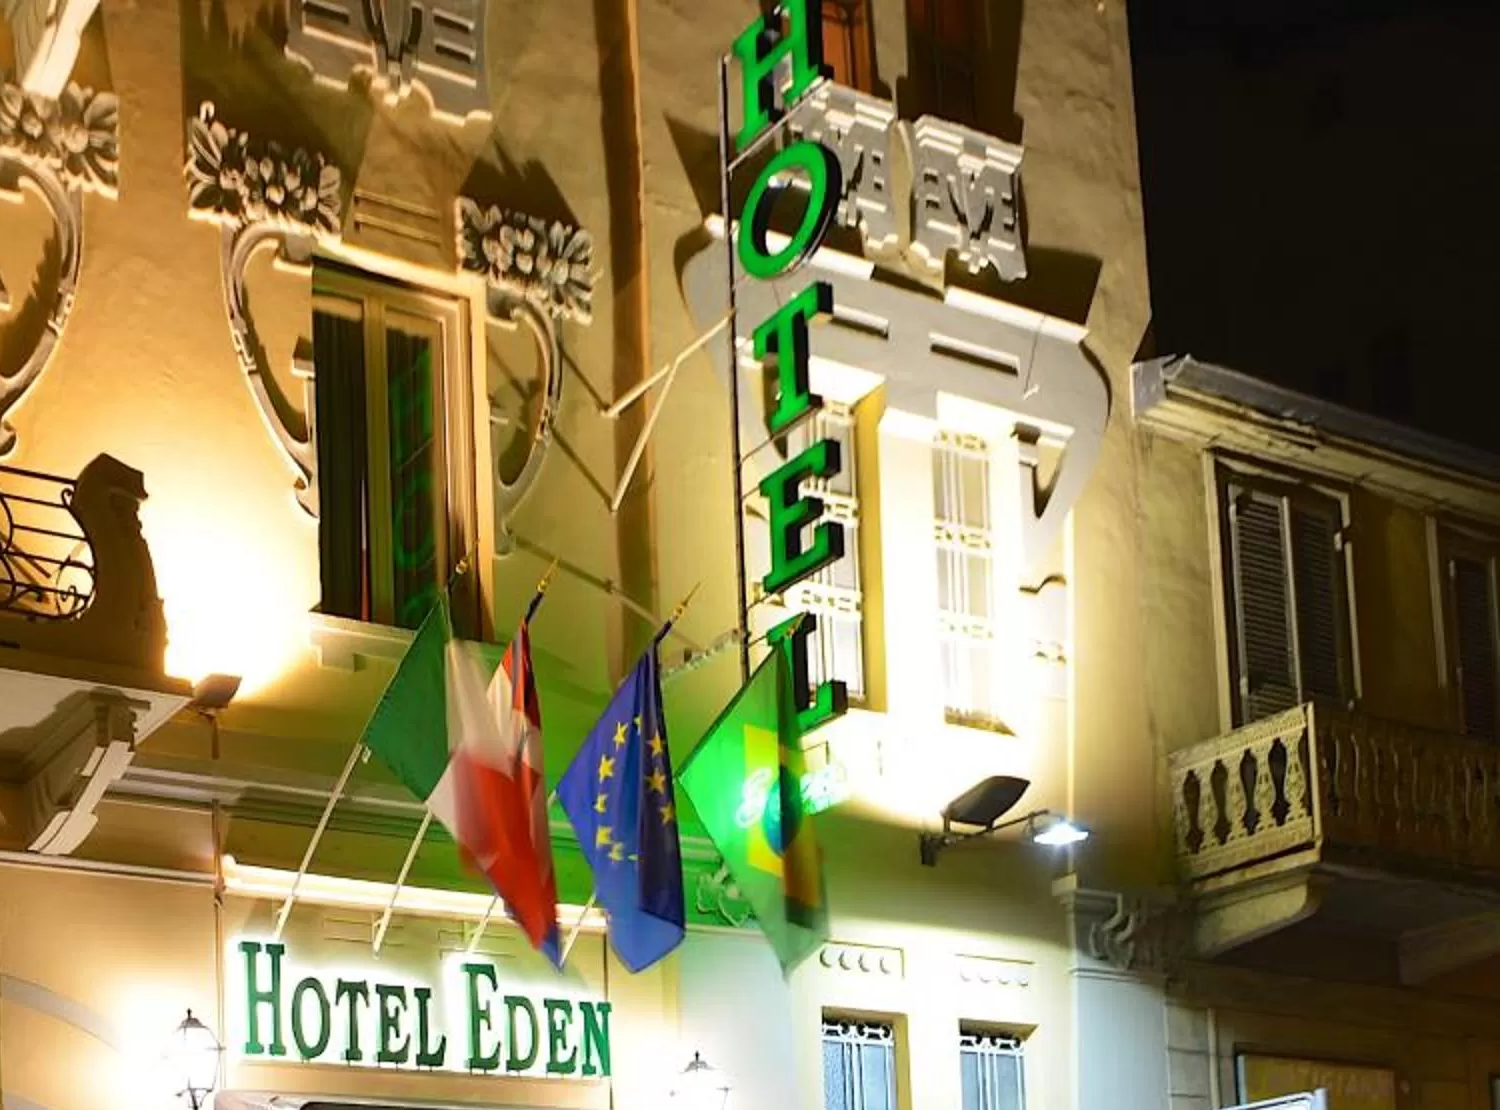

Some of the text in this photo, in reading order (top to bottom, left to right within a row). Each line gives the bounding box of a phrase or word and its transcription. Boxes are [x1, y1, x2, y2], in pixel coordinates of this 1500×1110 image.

[731, 0, 846, 716] HOTEL
[240, 941, 613, 1077] HOTEL EDEN
